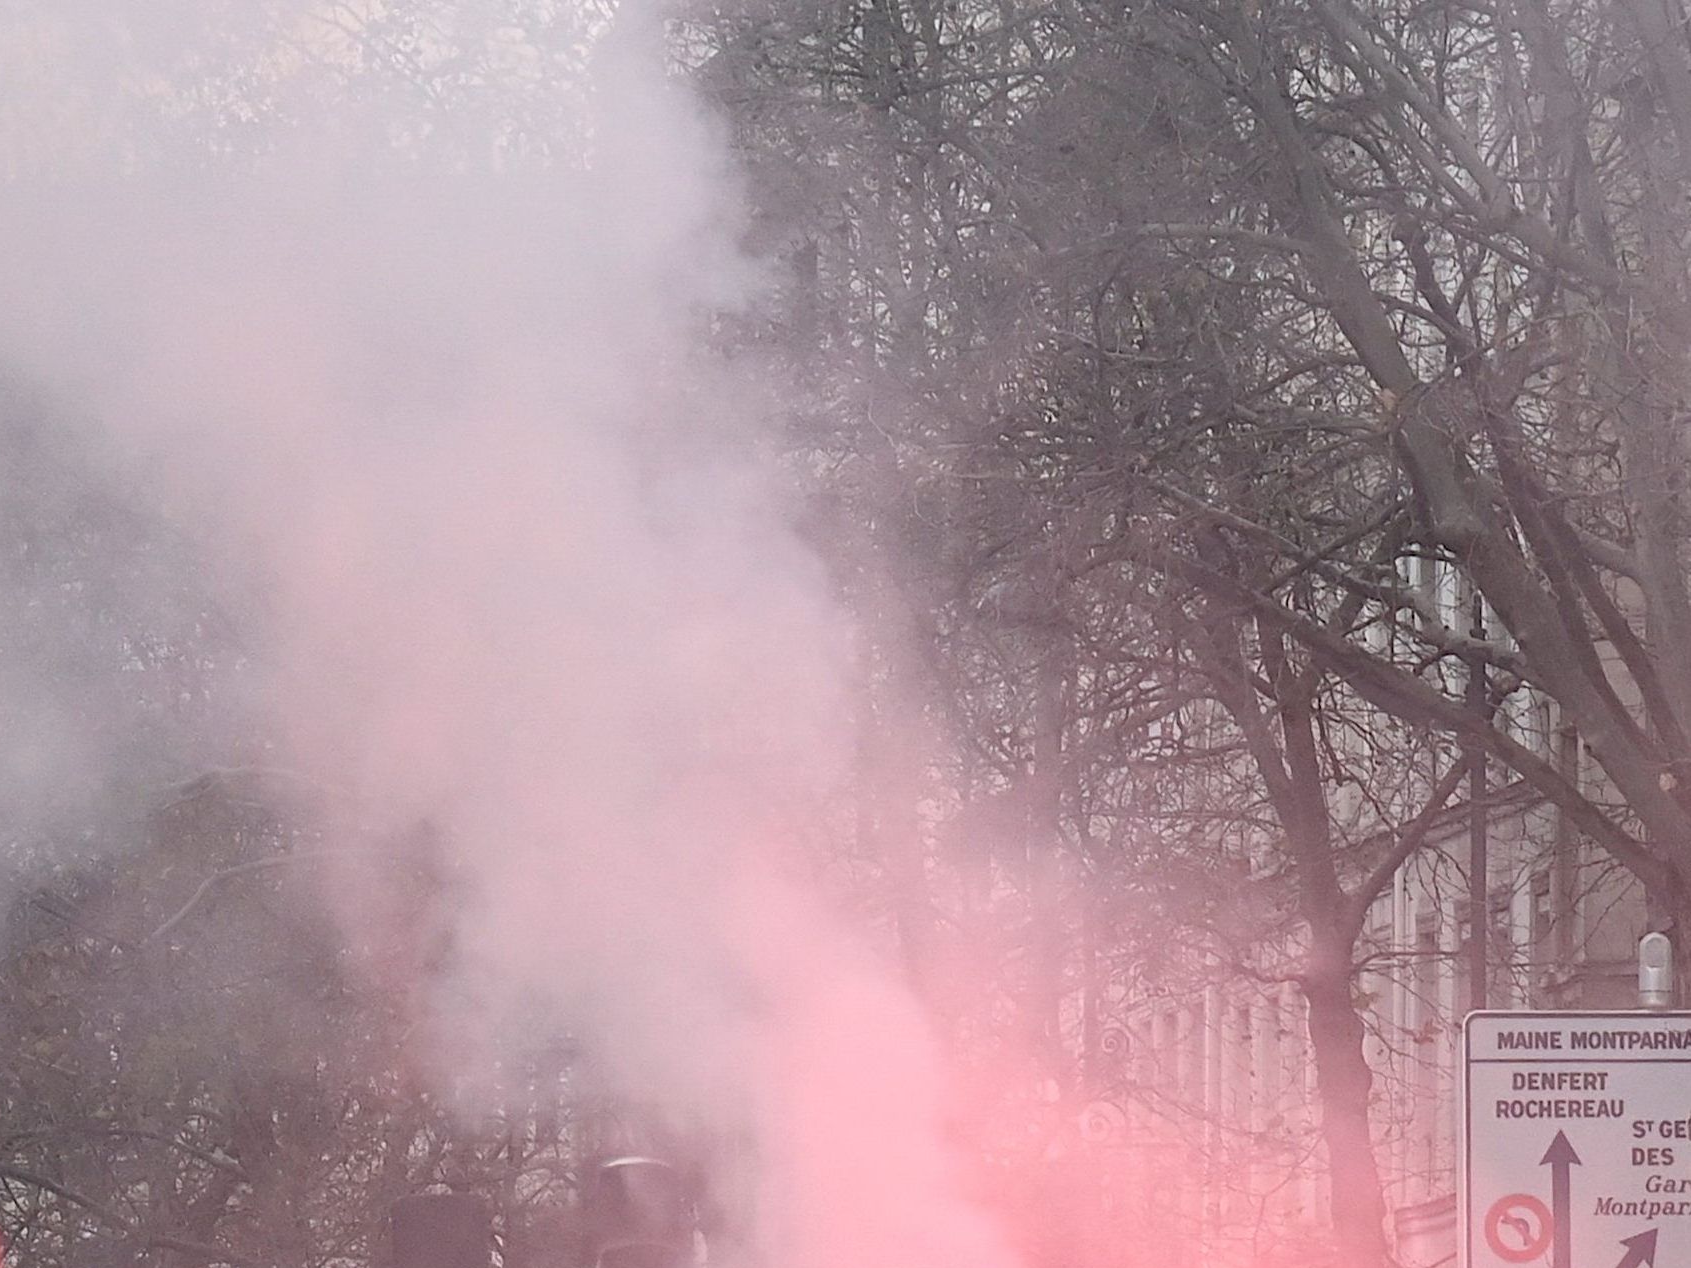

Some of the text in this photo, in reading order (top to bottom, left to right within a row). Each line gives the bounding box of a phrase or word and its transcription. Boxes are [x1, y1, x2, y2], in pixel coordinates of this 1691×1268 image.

[1497, 1032, 1562, 1050] MAINE
[1512, 1072, 1608, 1090] DENFERT
[1496, 1100, 1624, 1118] ROCHEREAU
[1659, 1120, 1691, 1138] GE
[1632, 1148, 1674, 1166] DES
[1594, 1197, 1691, 1219] Montpar
